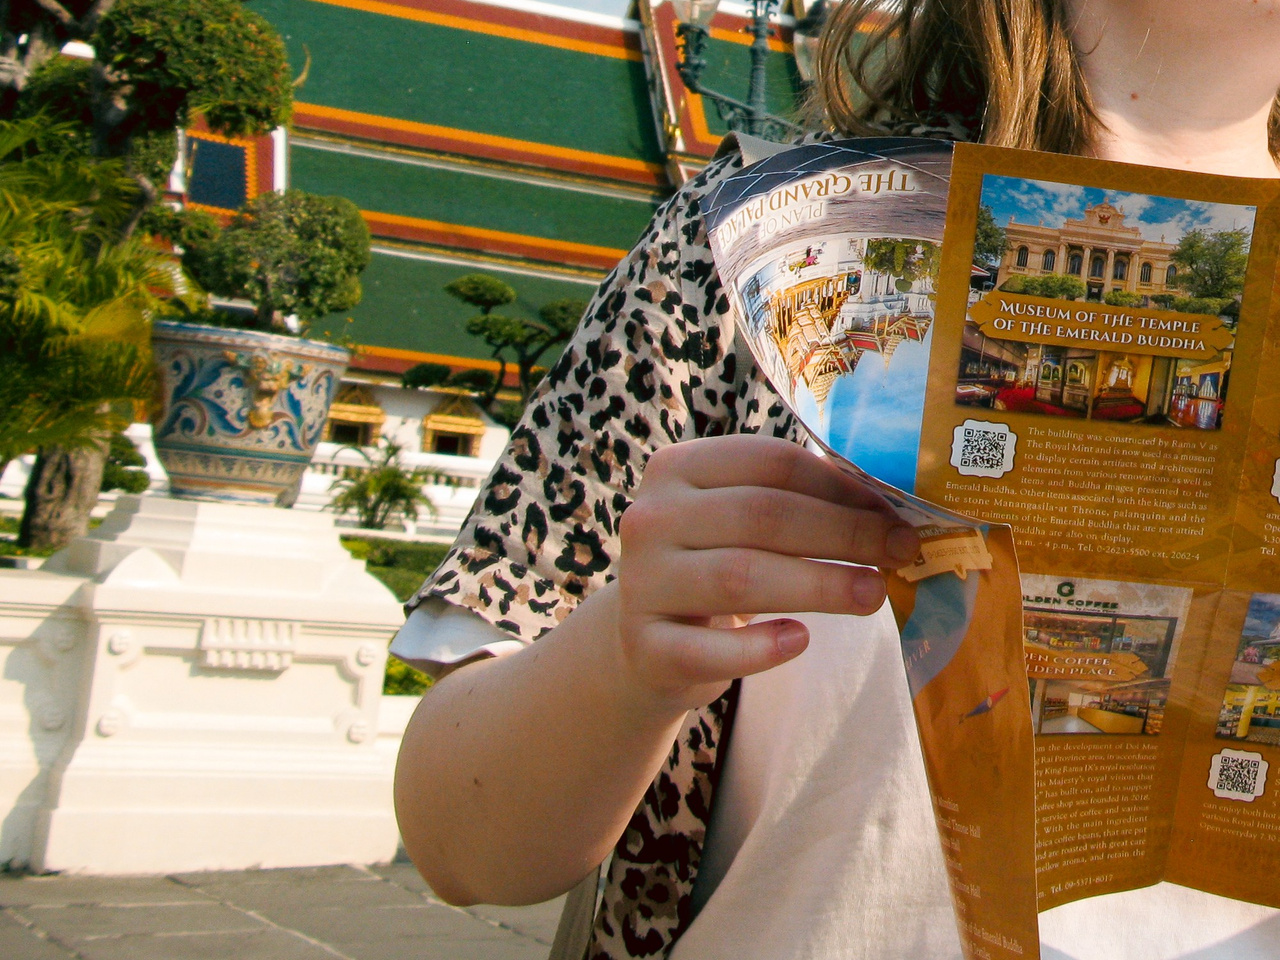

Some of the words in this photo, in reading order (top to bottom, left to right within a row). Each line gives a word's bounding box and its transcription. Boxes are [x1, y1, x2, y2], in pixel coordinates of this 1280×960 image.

[769, 173, 852, 211] GRAND
[858, 169, 916, 195] THE
[718, 199, 764, 250] PALACE
[781, 202, 824, 225] PLAN
[759, 217, 778, 240] OF
[1000, 300, 1070, 319] MUSEUM
[1074, 310, 1097, 322] OF
[1100, 313, 1133, 326] THE
[1137, 317, 1199, 332] TEMPLE
[993, 317, 1015, 330] OF
[1019, 321, 1051, 335] THE
[1056, 326, 1132, 343] EMERALD
[1137, 334, 1204, 350] BUDDHA
[1027, 426, 1045, 436] The
[1047, 428, 1084, 441] building
[1085, 433, 1102, 441] was
[1104, 435, 1156, 445] constructed
[1157, 437, 1169, 447] by
[1170, 439, 1196, 448] Rama
[1198, 441, 1207, 449] V
[943, 493, 960, 502] the
[962, 496, 990, 505] stone
[1071, 504, 1109, 516] Throne,
[1112, 509, 1165, 520] palanquins
[1168, 512, 1187, 522] and
[1189, 514, 1206, 523] the
[1066, 599, 1119, 609] COFFEE
